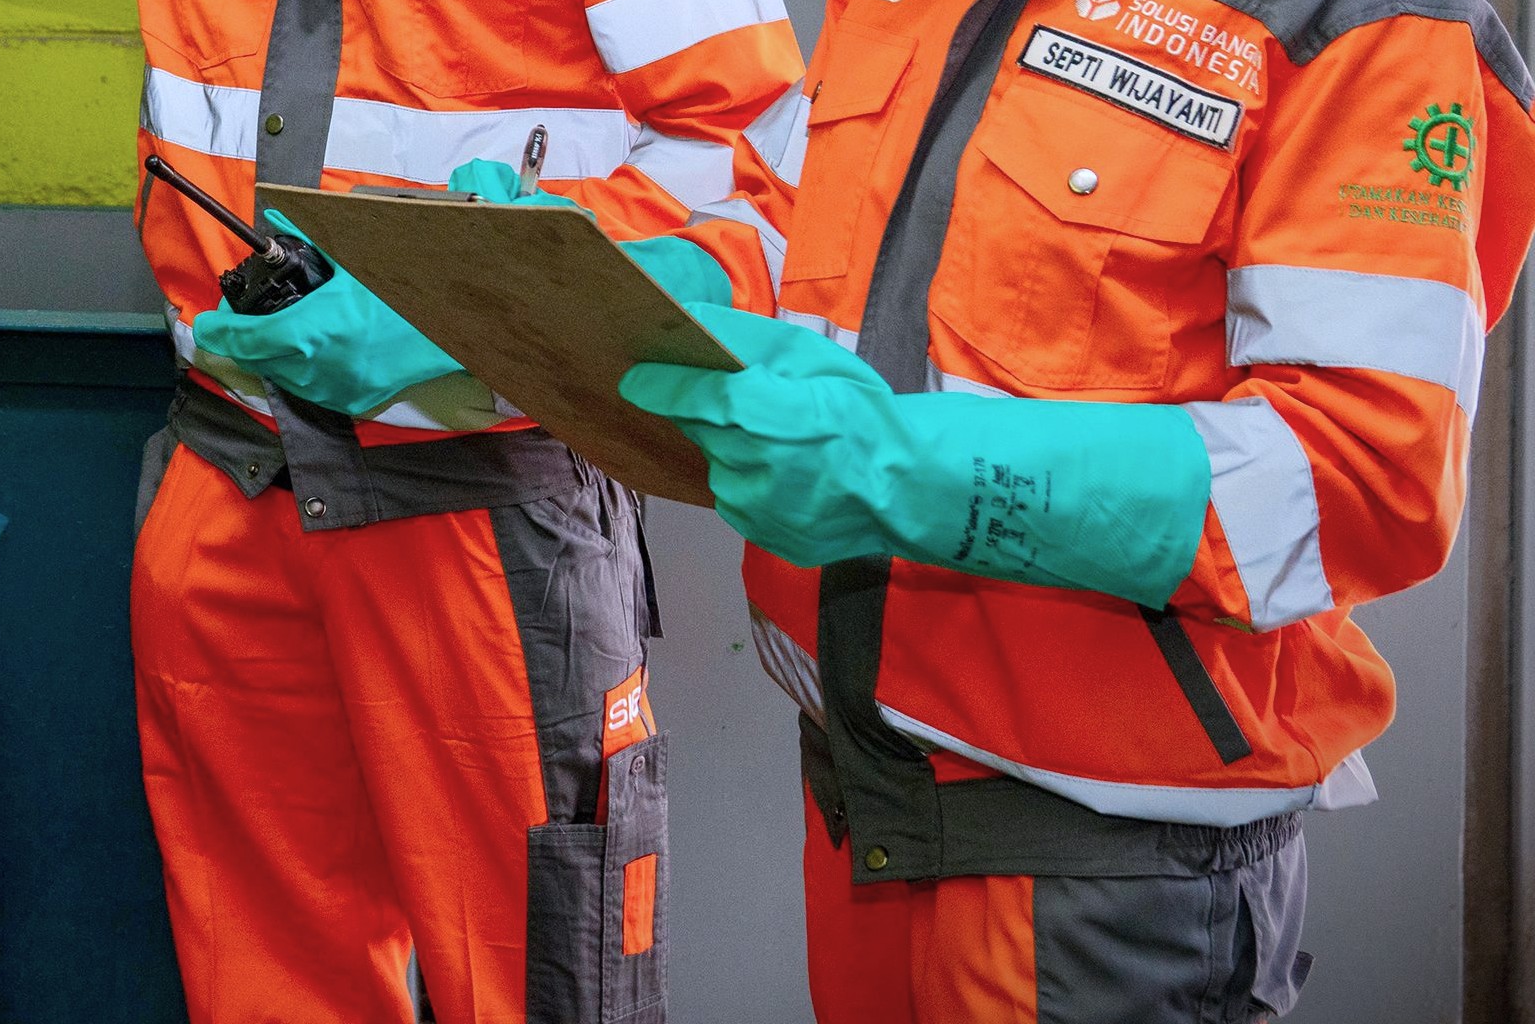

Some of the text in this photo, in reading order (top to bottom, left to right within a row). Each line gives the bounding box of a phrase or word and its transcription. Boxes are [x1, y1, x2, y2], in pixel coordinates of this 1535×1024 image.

[1116, 12, 1260, 95] INDONESIA
[1044, 42, 1224, 134] SEPTI WIJAYANTI
[1338, 184, 1431, 206] UTAMAKAN
[1349, 203, 1467, 232] DAN KESEHAT
